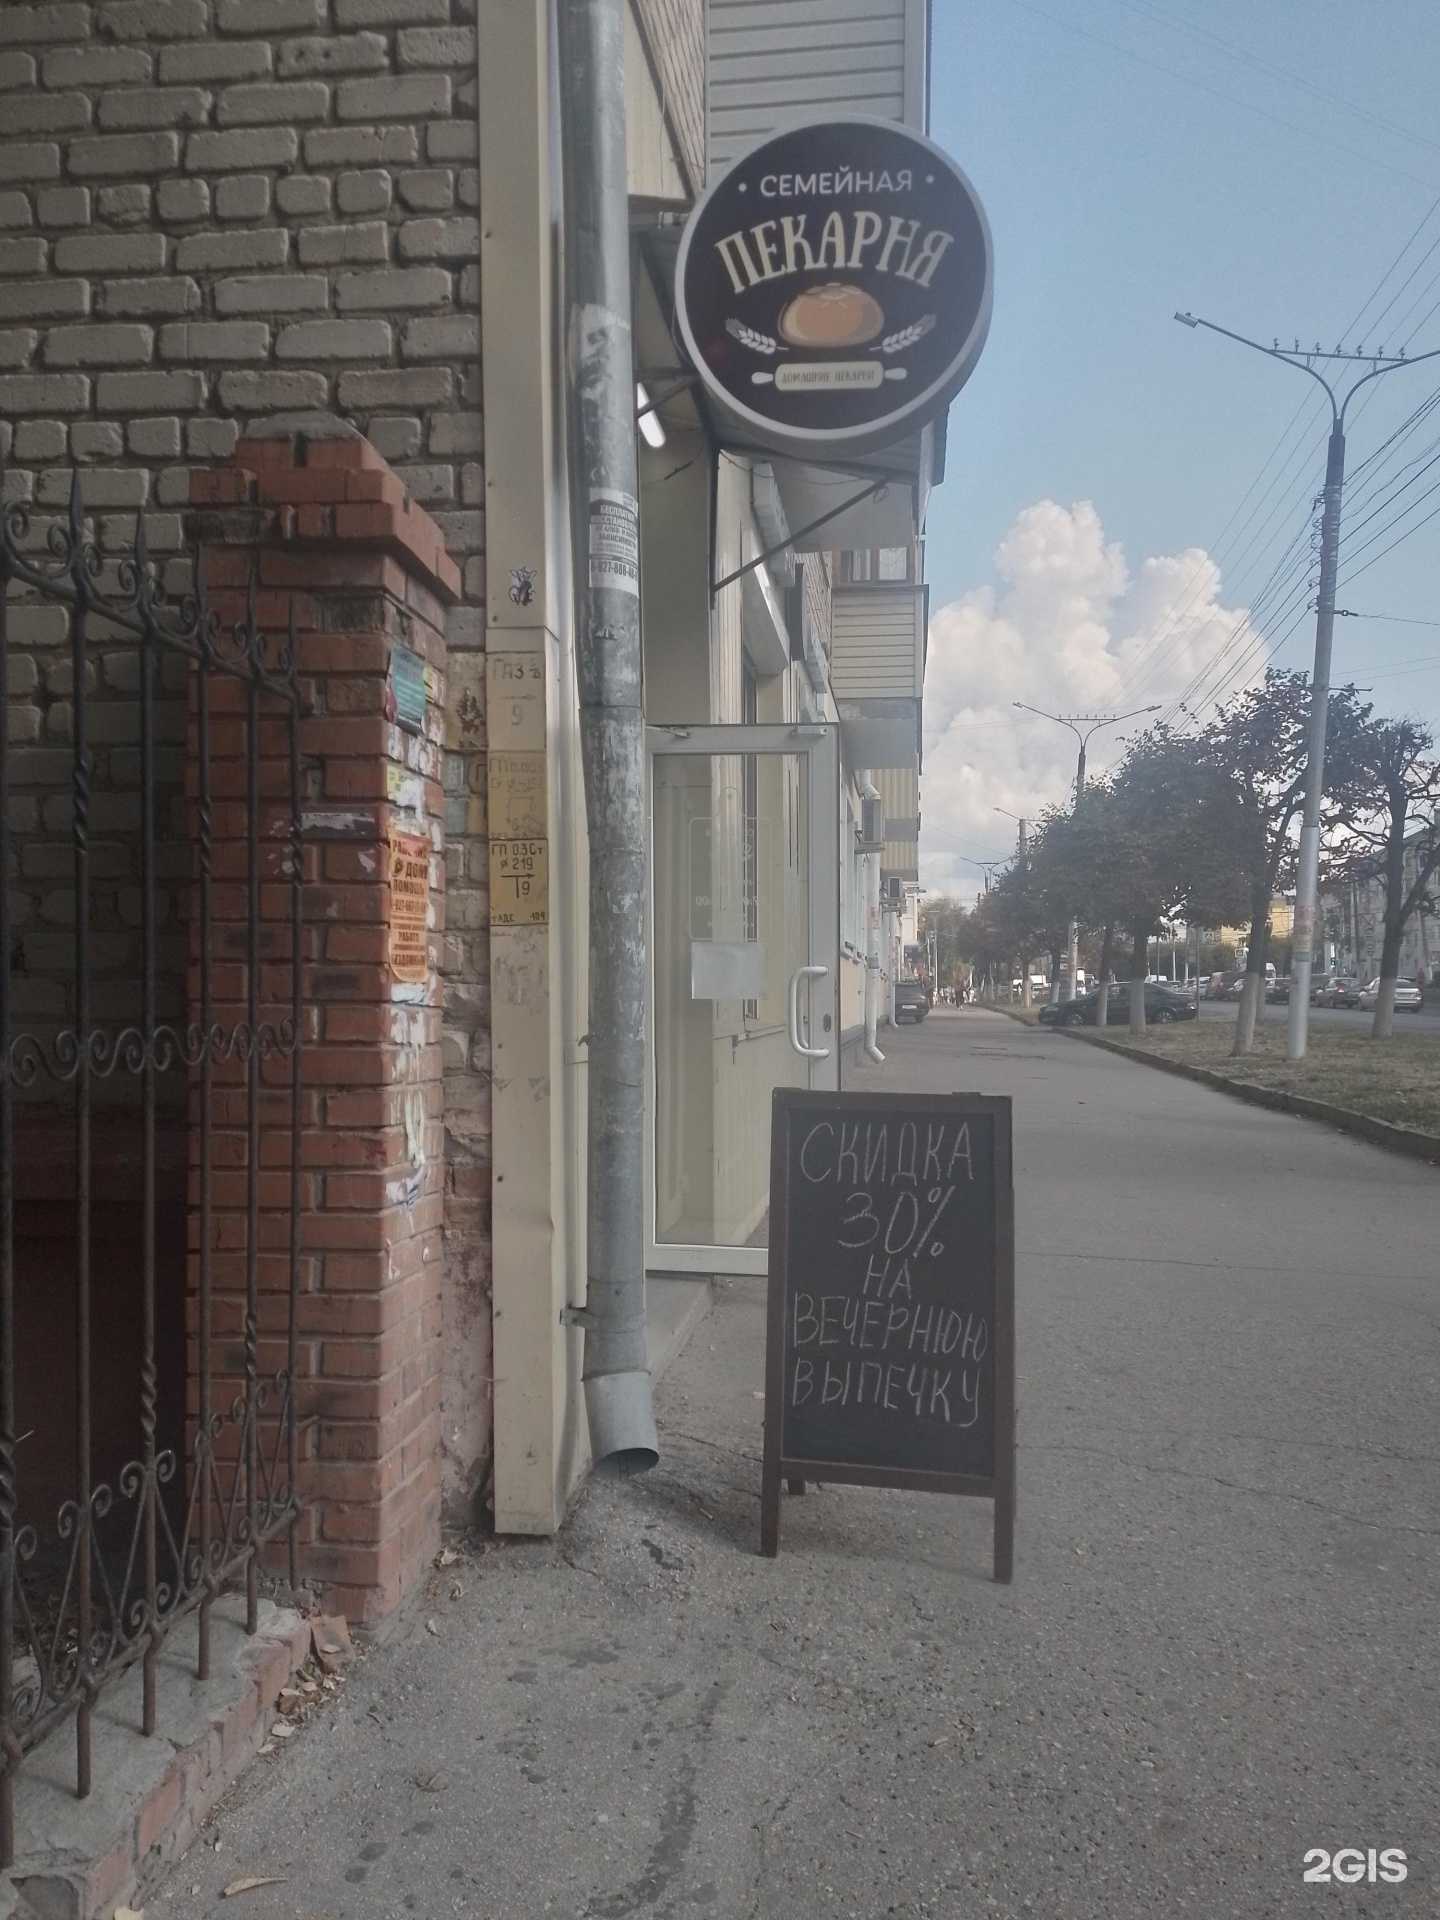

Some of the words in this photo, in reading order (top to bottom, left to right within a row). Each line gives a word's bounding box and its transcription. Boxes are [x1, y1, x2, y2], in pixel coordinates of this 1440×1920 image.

[760, 166, 912, 197] СЕМЕЙНАЯ
[714, 211, 954, 294] ПЕКАРНЯ
[800, 1122, 974, 1187] СКИДКА
[838, 1185, 956, 1259] 30%
[863, 1254, 912, 1300] НА
[794, 1289, 988, 1362] ВЕЧЕРНЮЮ
[792, 1357, 981, 1428] ВЫПЕЧКУ
